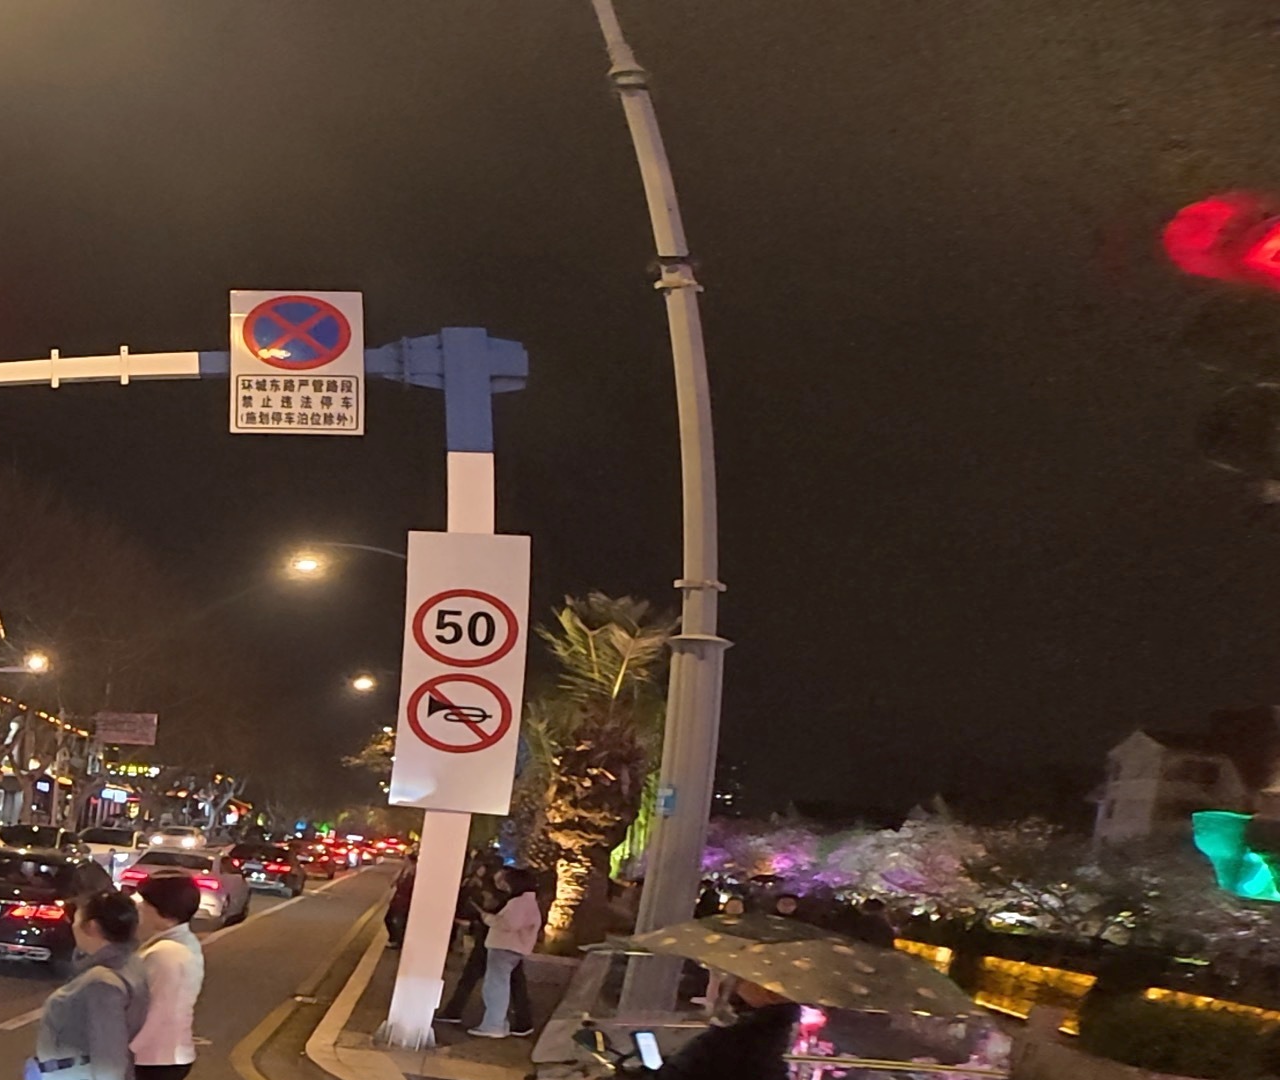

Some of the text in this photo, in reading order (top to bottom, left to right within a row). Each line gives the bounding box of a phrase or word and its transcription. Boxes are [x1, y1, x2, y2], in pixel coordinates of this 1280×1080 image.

[241, 378, 354, 393] 环城东路严管路段
[241, 395, 354, 410] 禁止违法停车
[435, 609, 496, 647] 50
